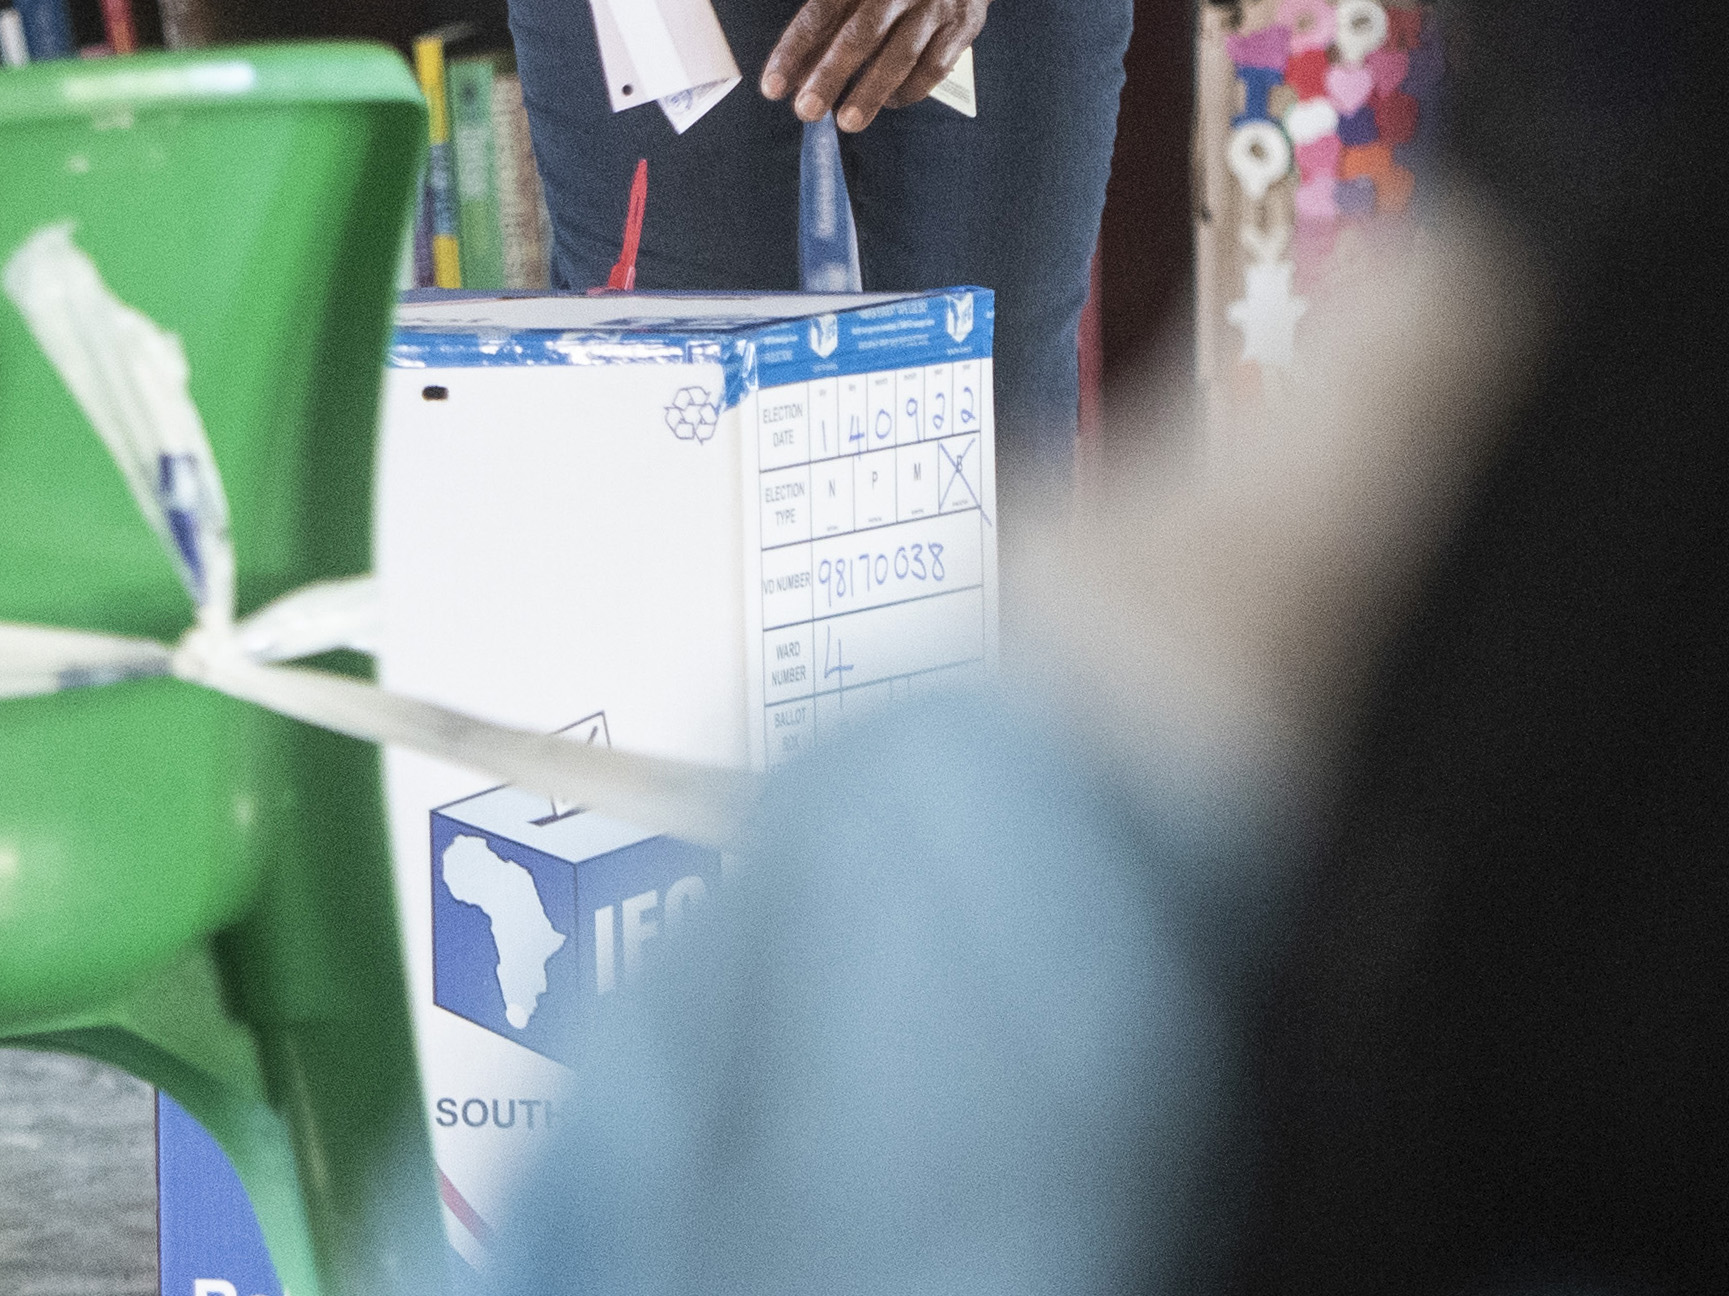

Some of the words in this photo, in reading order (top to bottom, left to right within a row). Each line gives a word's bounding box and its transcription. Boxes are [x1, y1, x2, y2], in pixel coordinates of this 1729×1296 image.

[763, 402, 803, 424] ELECTION
[773, 429, 794, 447] DATE
[828, 479, 836, 498] N
[871, 471, 879, 490] P
[913, 462, 922, 481] M
[765, 482, 805, 503] ELECTION
[775, 508, 796, 526] TYPE
[763, 578, 775, 595] VD
[776, 571, 812, 593] NUMBER
[776, 641, 801, 661] WARD
[771, 665, 807, 688] NUMBER
[774, 707, 806, 729] BALLOT
